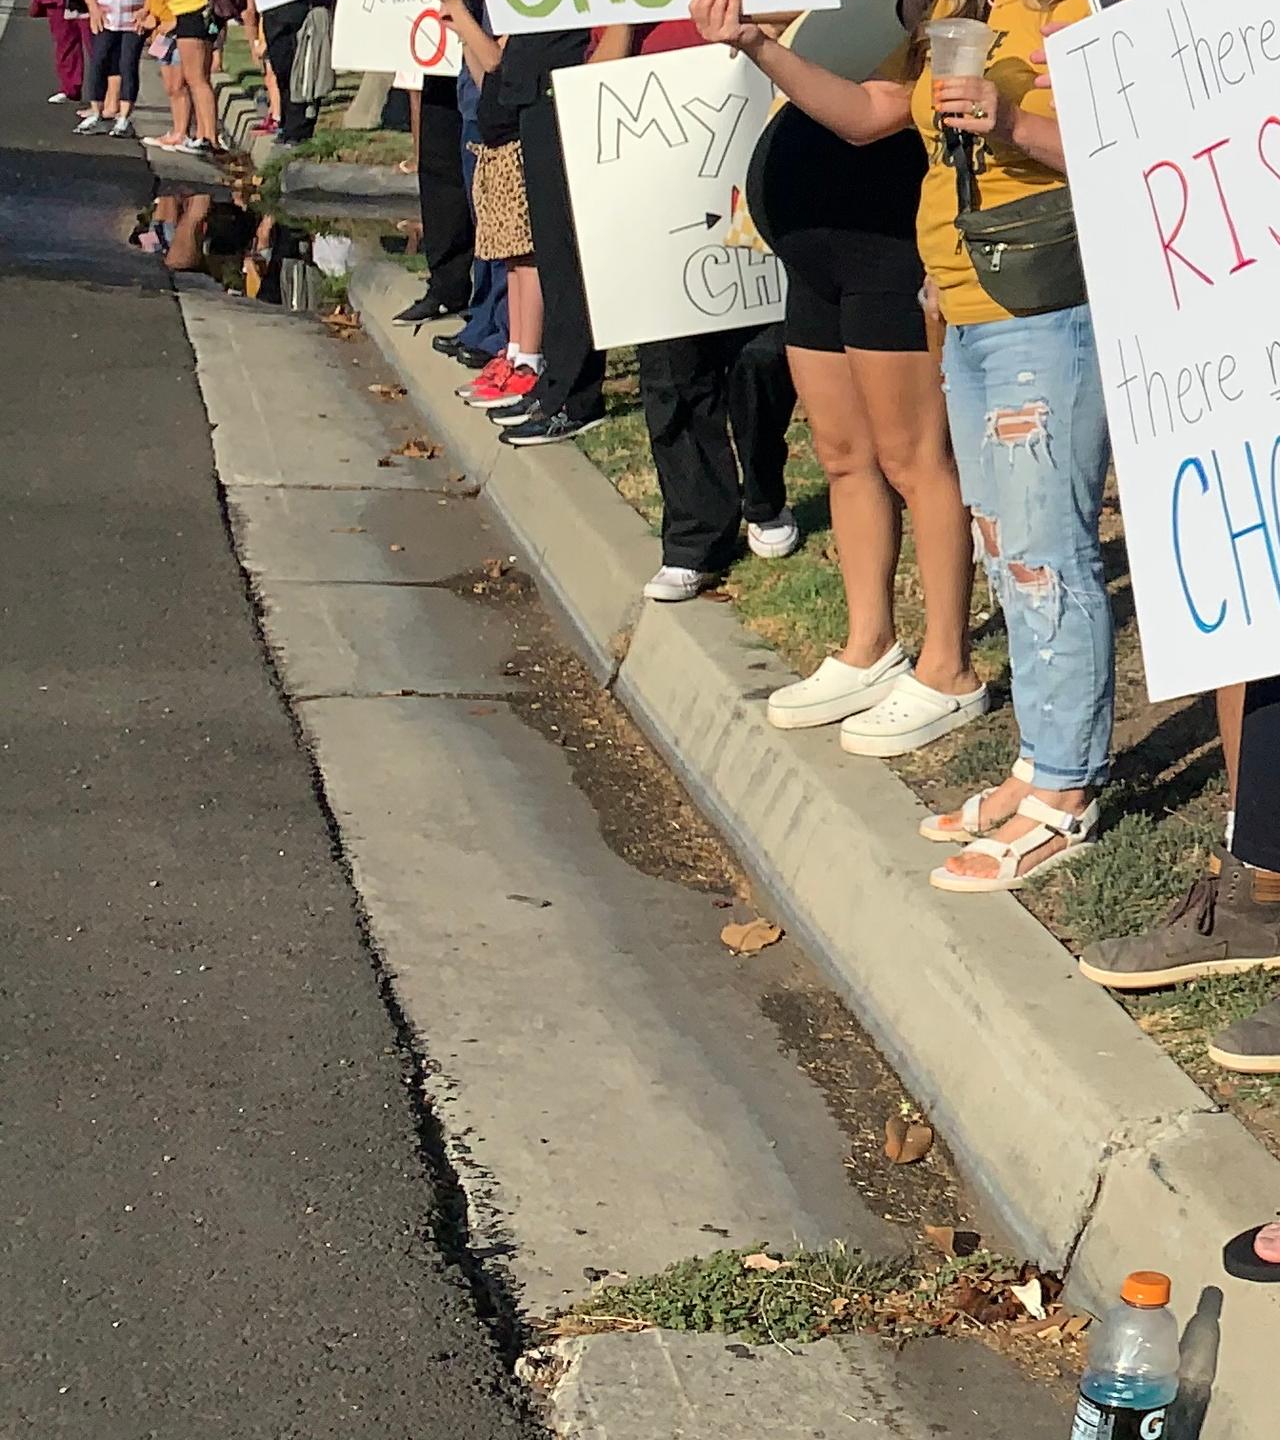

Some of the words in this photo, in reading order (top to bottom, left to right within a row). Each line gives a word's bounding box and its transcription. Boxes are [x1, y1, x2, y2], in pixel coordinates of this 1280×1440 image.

[1067, 30, 1140, 158] If
[1116, 337, 1244, 445] there
[1140, 1408, 1166, 1440] G
